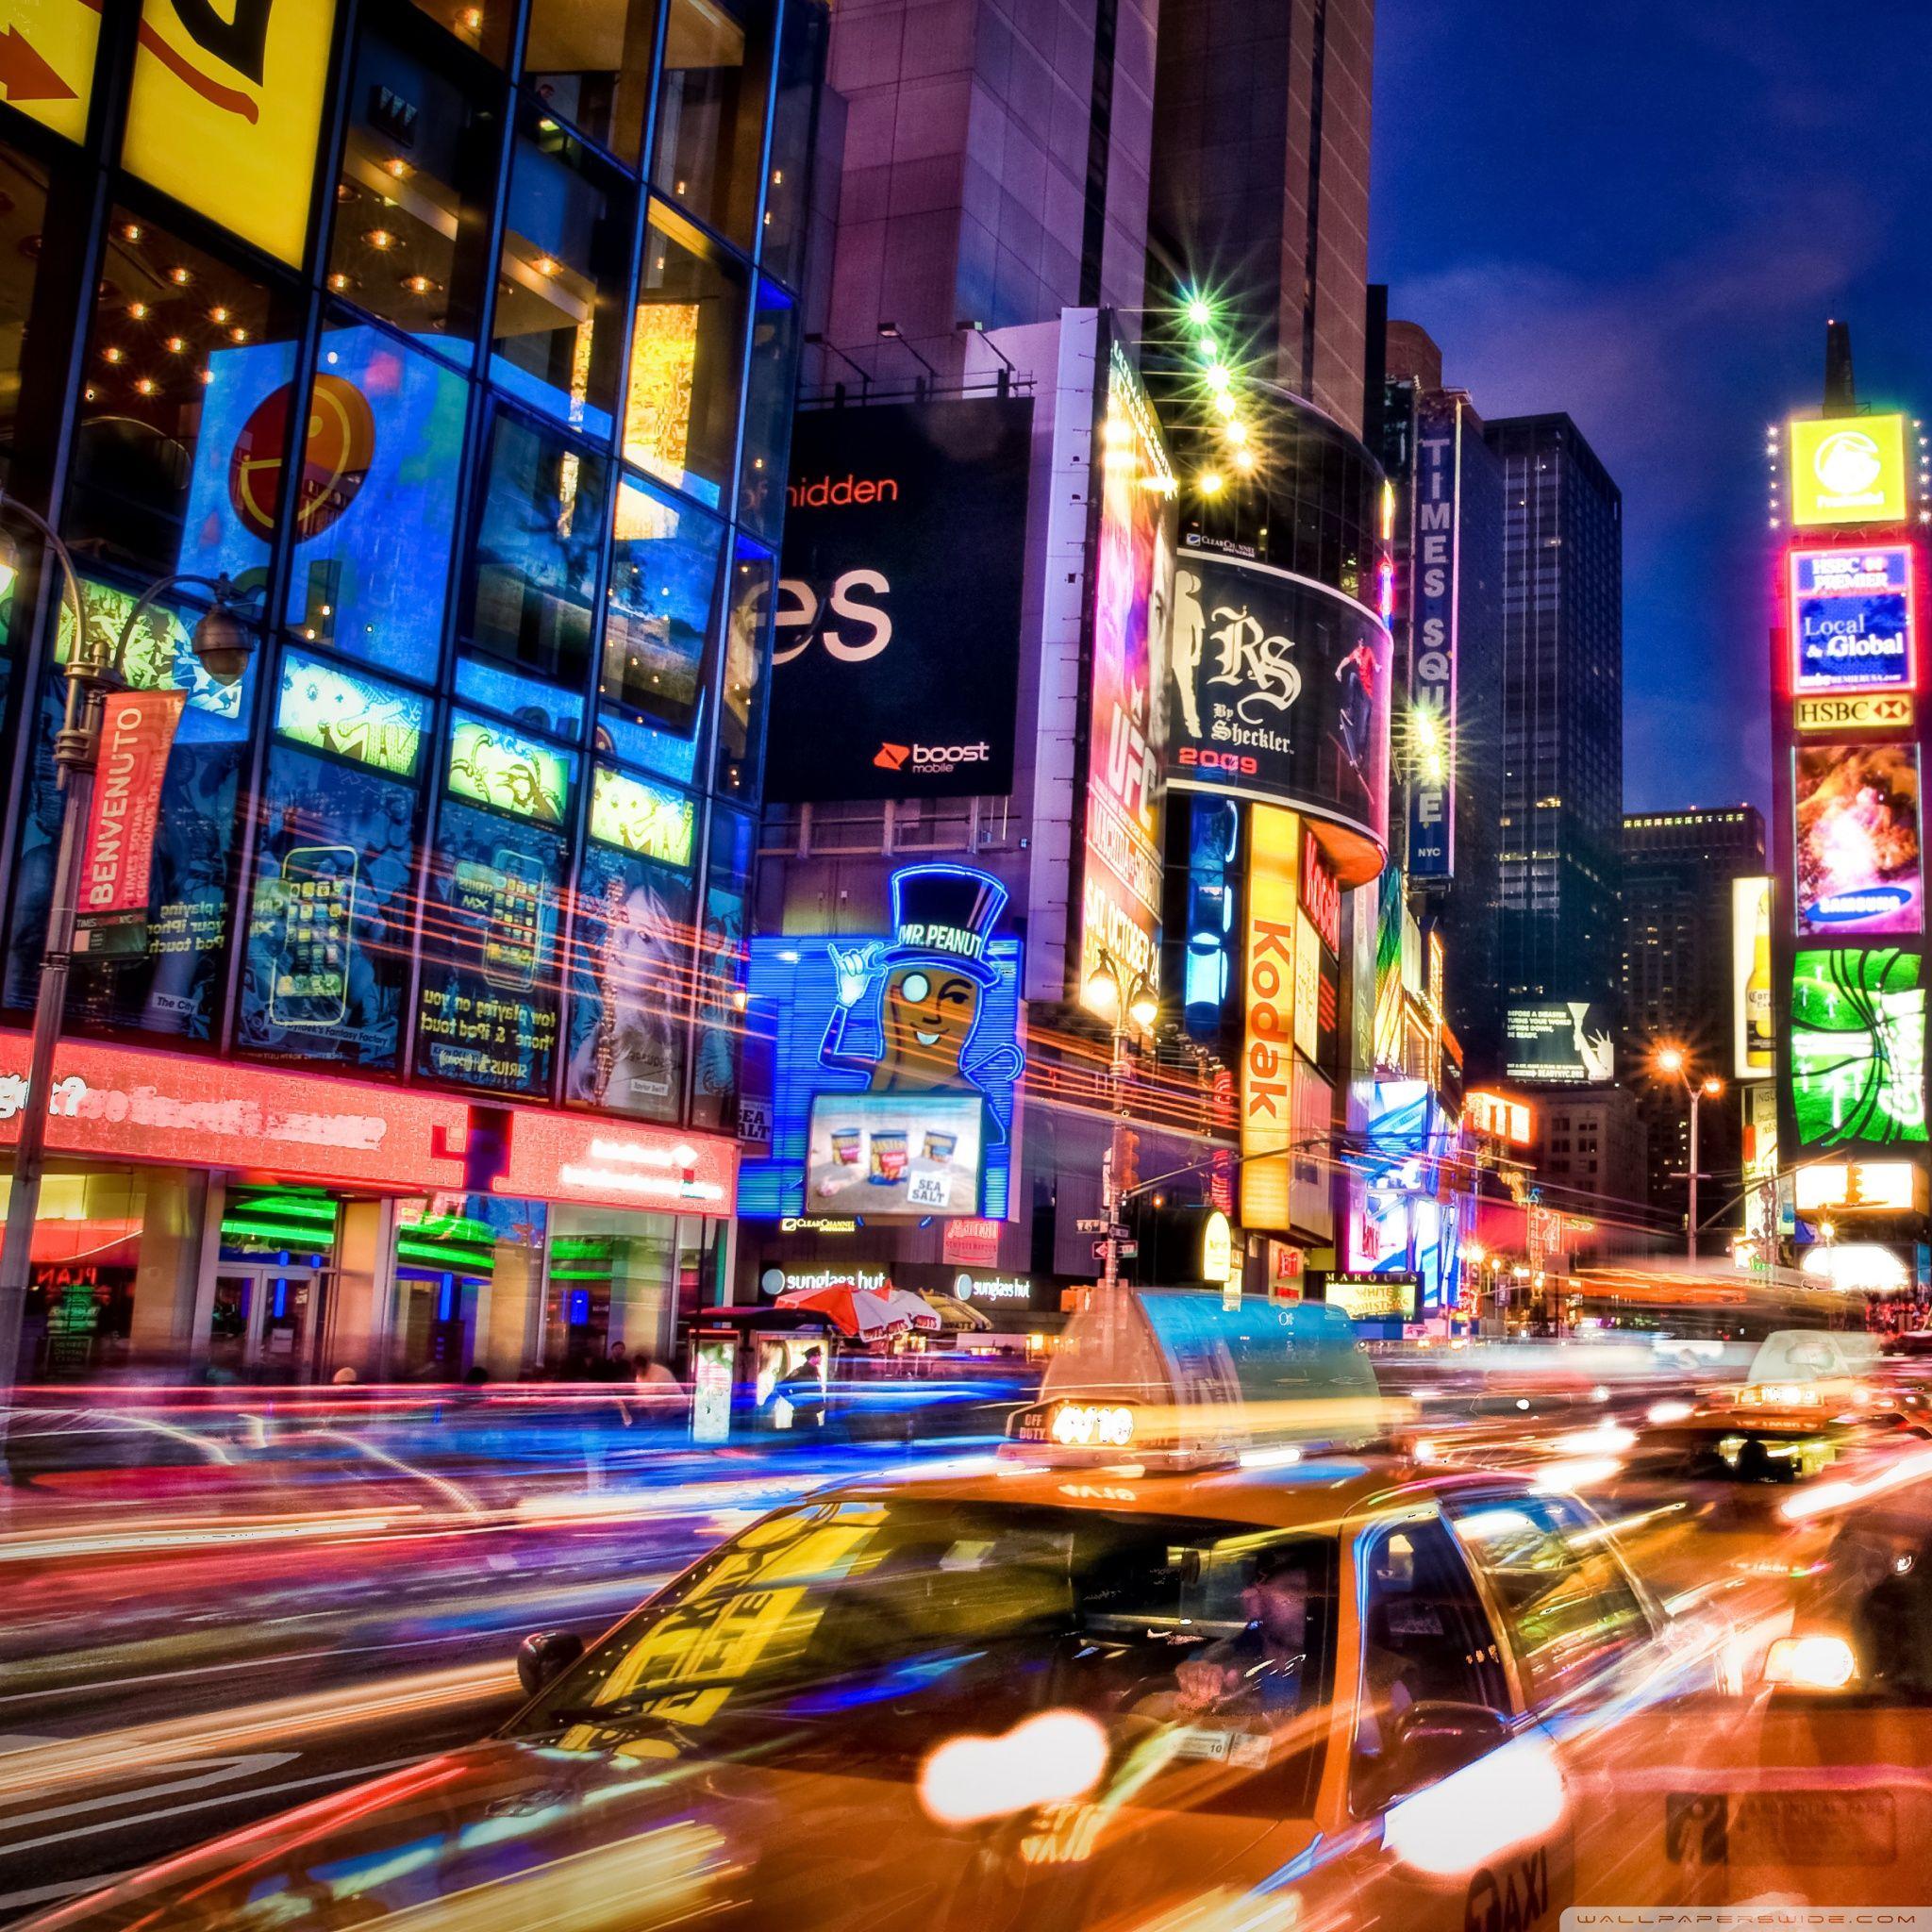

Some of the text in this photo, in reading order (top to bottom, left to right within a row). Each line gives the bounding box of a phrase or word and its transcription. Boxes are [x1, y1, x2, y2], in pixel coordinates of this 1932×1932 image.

[1418, 439, 1451, 824] TIMES SQUE
[1804, 614, 1865, 637] Local
[1807, 632, 1905, 658] & Global
[1213, 703, 1234, 724] By
[1799, 701, 1869, 724] HSBC
[1210, 719, 1291, 754] Sheckler
[912, 741, 991, 763] boost
[1179, 746, 1258, 775] 2009
[912, 762, 955, 774] mobile
[1108, 701, 1158, 832] UFC
[89, 707, 142, 906] BENVENUTO
[1418, 848, 1441, 858] NYC
[1818, 895, 1901, 914] SAMSUNG
[926, 924, 982, 959] PEANUT
[1248, 920, 1291, 1120] Kodak
[918, 1179, 941, 1191] SEA
[911, 1189, 945, 1204] SALT
[858, 1270, 886, 1291] hut
[973, 1274, 1031, 1301] sunglass hut
[1324, 1272, 1418, 1283] MARQUIS
[1356, 1285, 1394, 1299] WHITE
[1019, 1427, 1046, 1441] DUTY
[1210, 1744, 1223, 1754] 10
